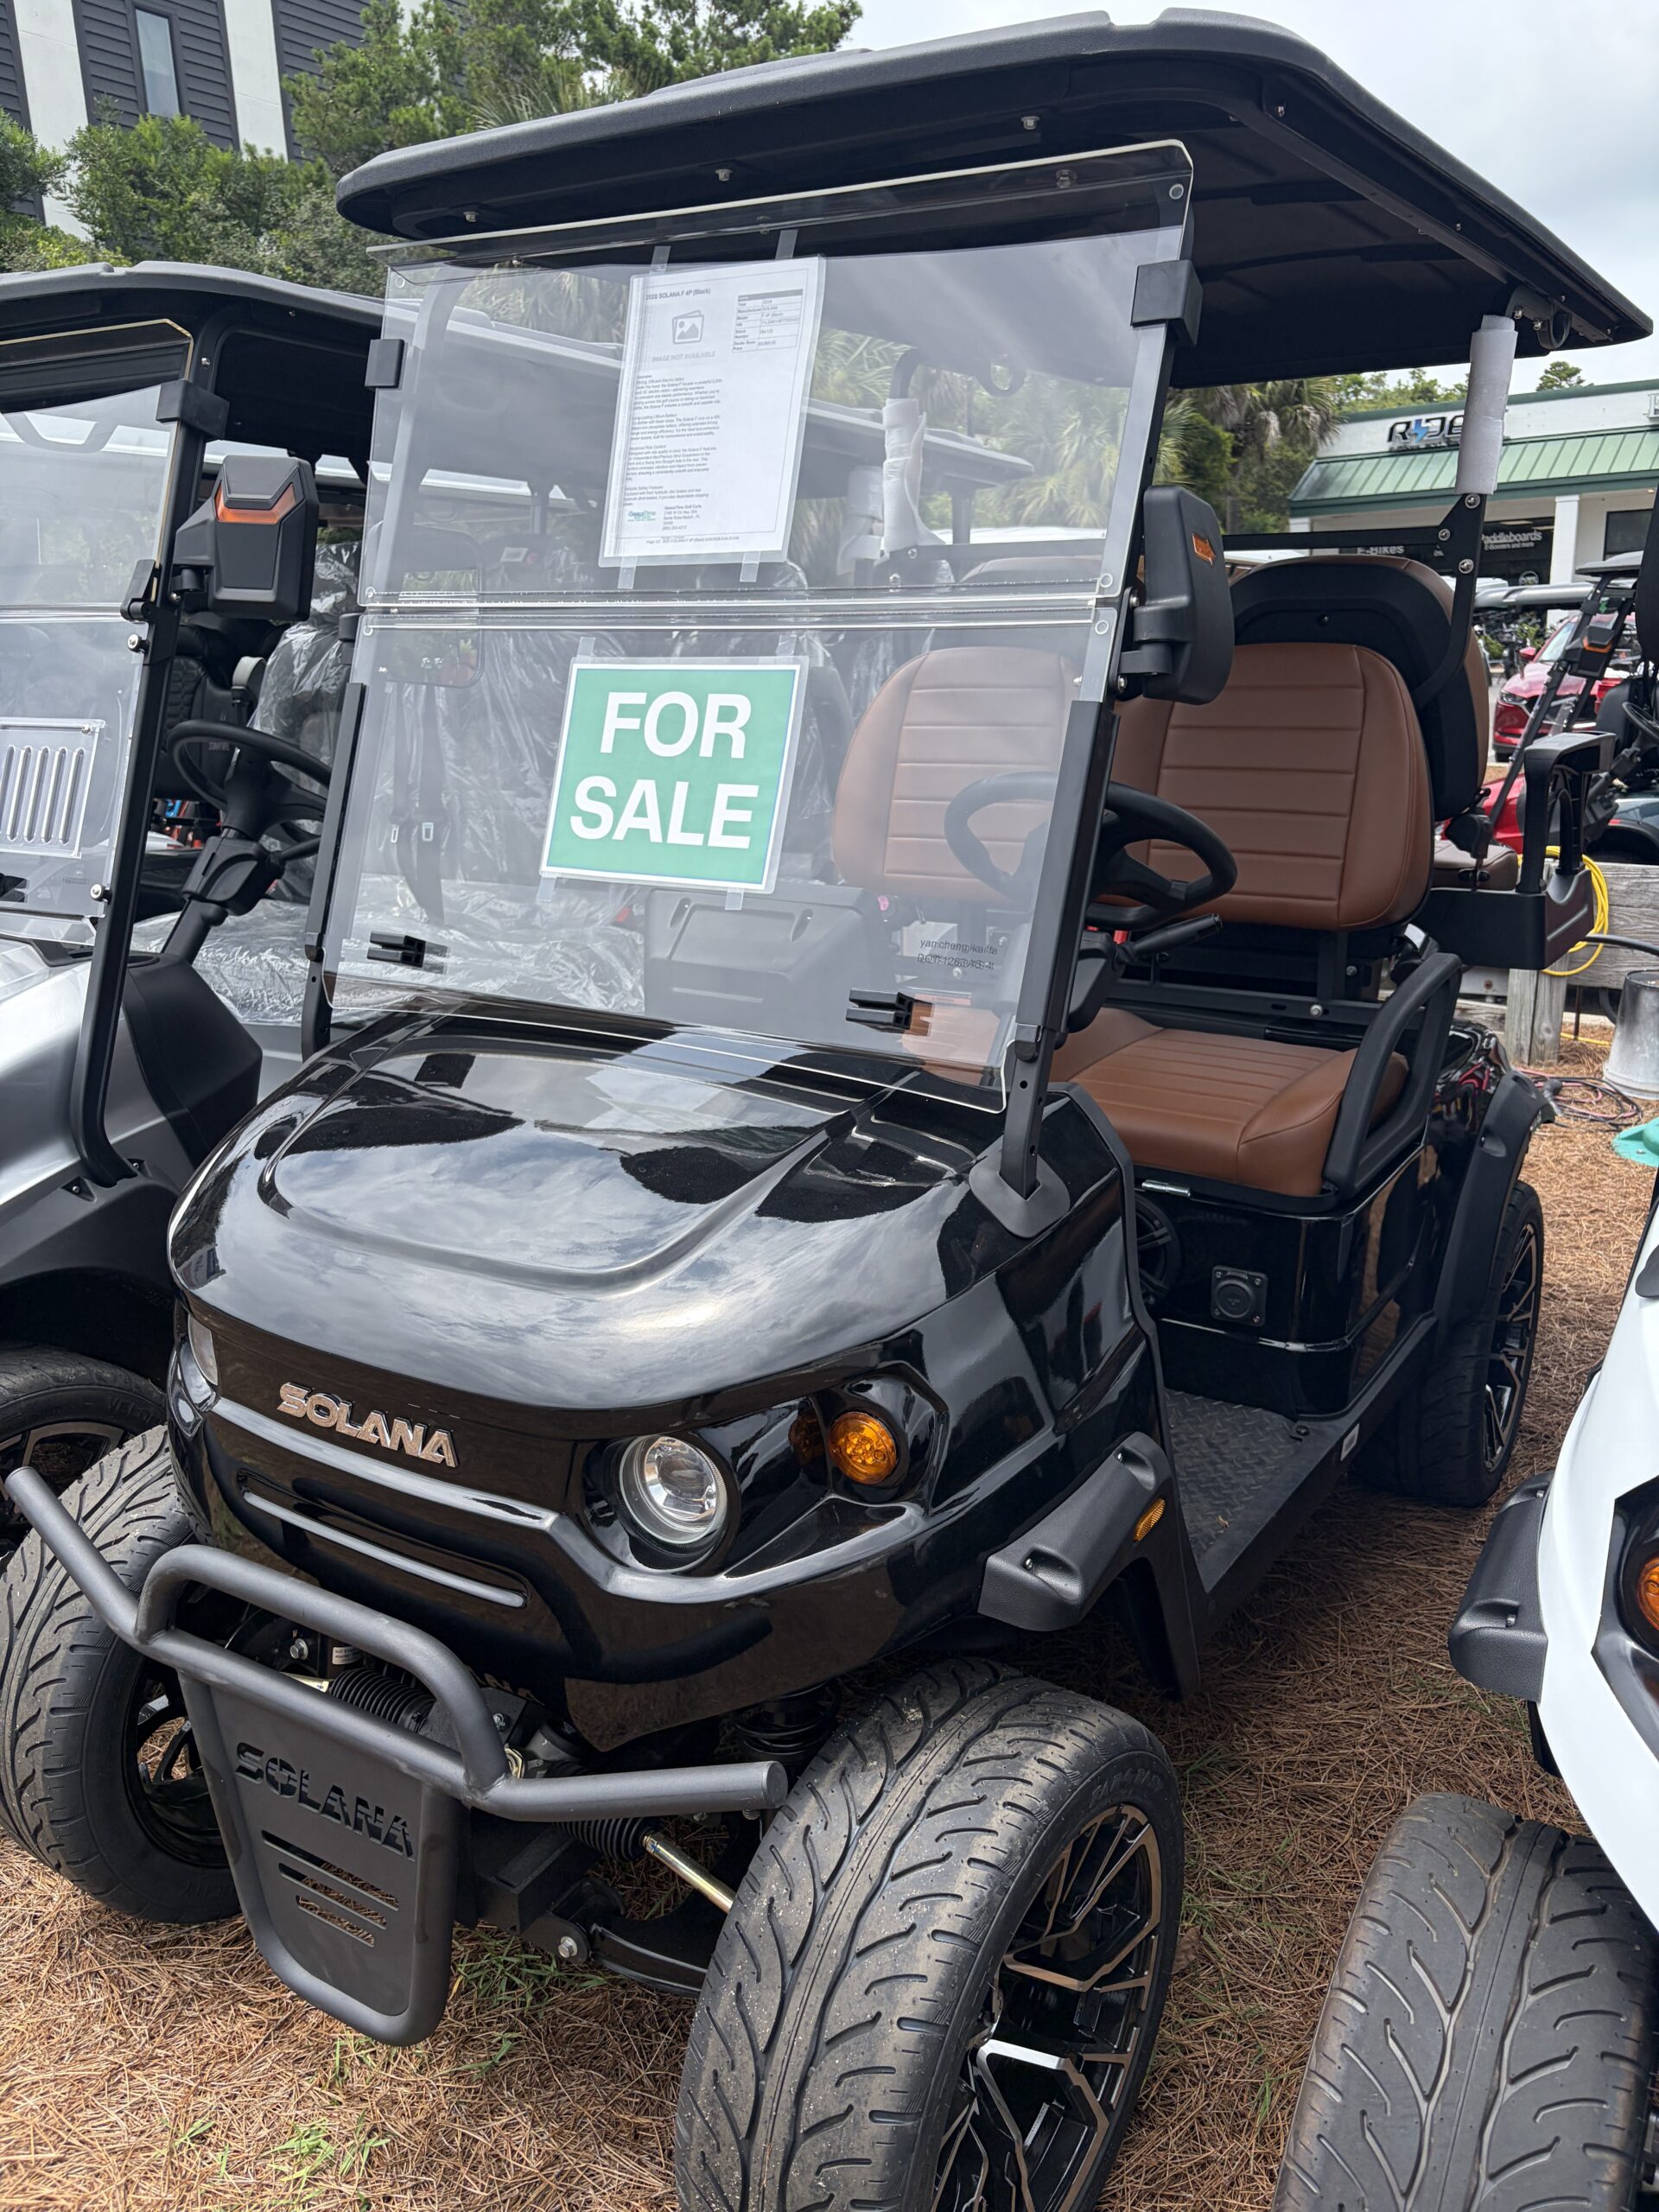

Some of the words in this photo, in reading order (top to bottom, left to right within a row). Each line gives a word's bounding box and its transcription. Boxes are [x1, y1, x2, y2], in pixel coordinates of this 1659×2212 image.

[693, 288, 710, 296] (Black)
[683, 351, 715, 359] AVAILABLE
[600, 691, 752, 760] FOR
[570, 775, 760, 849] SALE
[277, 1382, 458, 1467] SOLANA
[236, 1742, 415, 1860] SOLANA
